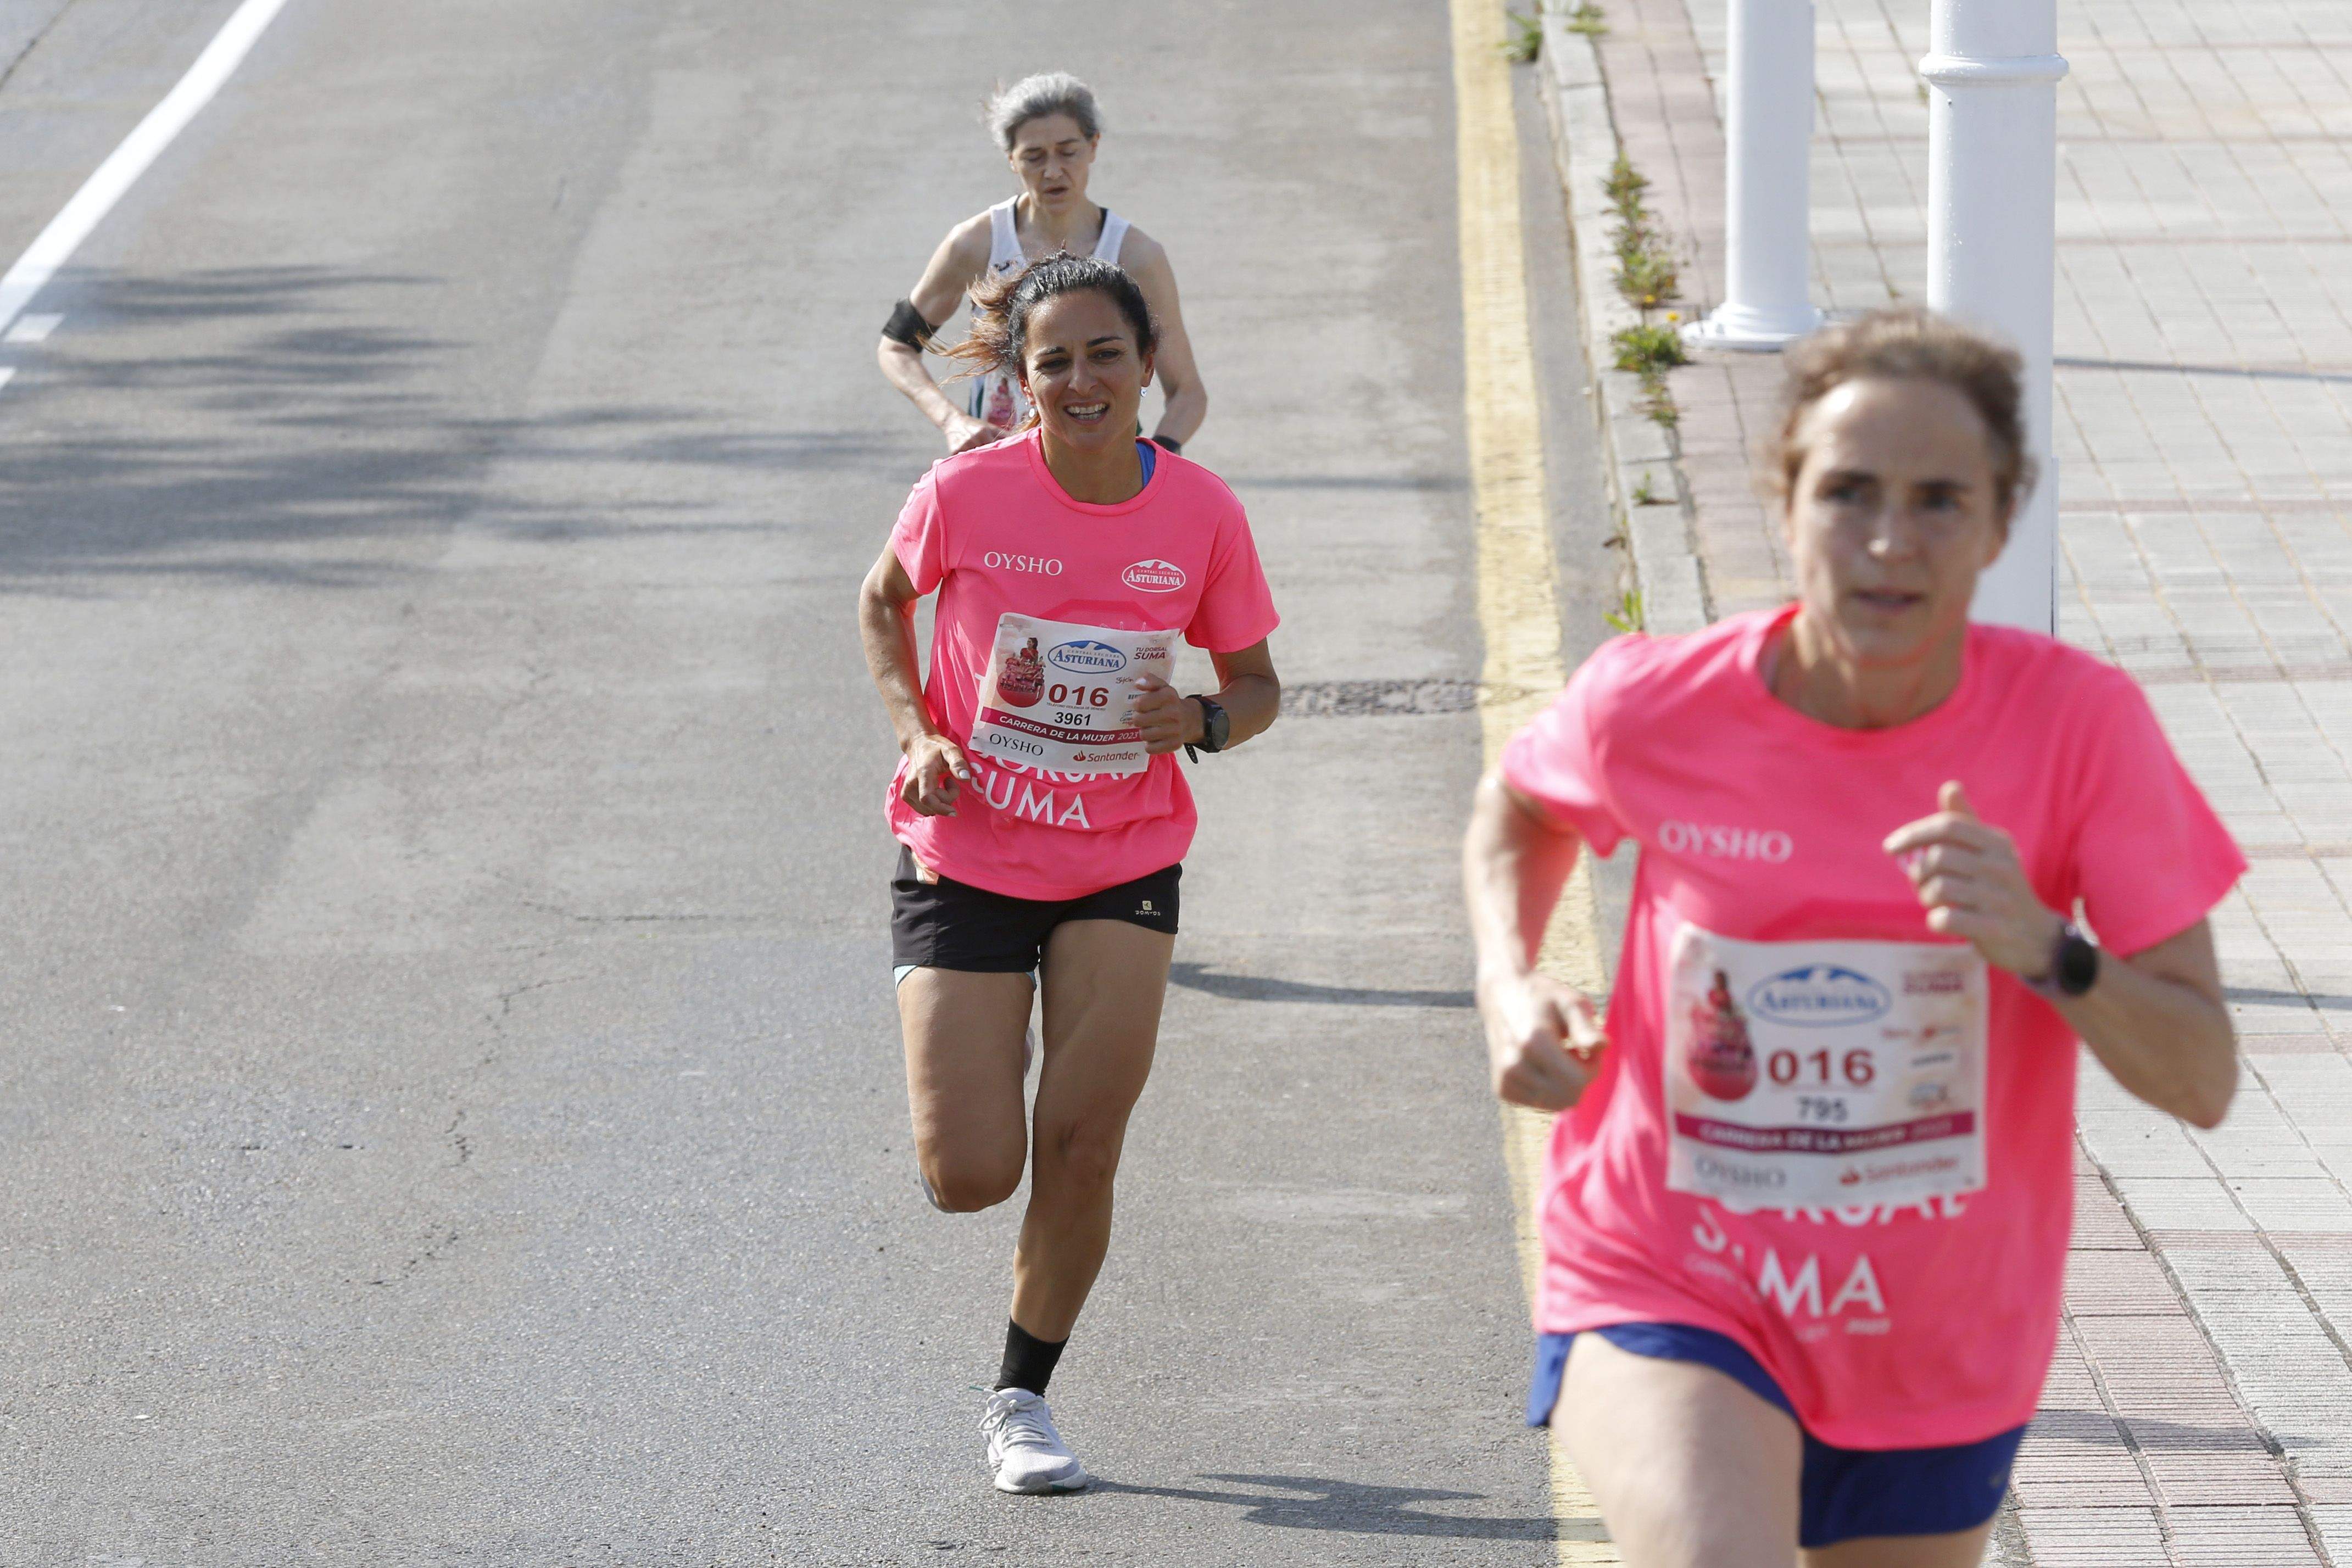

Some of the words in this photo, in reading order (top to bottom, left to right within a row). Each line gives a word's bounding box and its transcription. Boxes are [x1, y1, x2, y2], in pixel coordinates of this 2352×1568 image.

[984, 551, 1063, 576] OYSHO
[1126, 570, 1180, 585] ASTURIANA
[1053, 649, 1119, 668] ASTURIANA
[1048, 683, 1110, 707] 016
[999, 716, 1047, 735] CARRERA
[1049, 729, 1065, 739] DE
[1066, 732, 1079, 740] LA
[1117, 732, 1139, 740] 2023
[1054, 711, 1091, 726] 3961
[989, 733, 1044, 756] OYSHO
[1087, 751, 1139, 762] Santander
[1658, 819, 1793, 864] OYSHO
[1767, 1047, 1876, 1087] 016
[1798, 1097, 1849, 1121] 795
[1786, 1132, 1812, 1150] DE
[1814, 1133, 1842, 1151] LA
